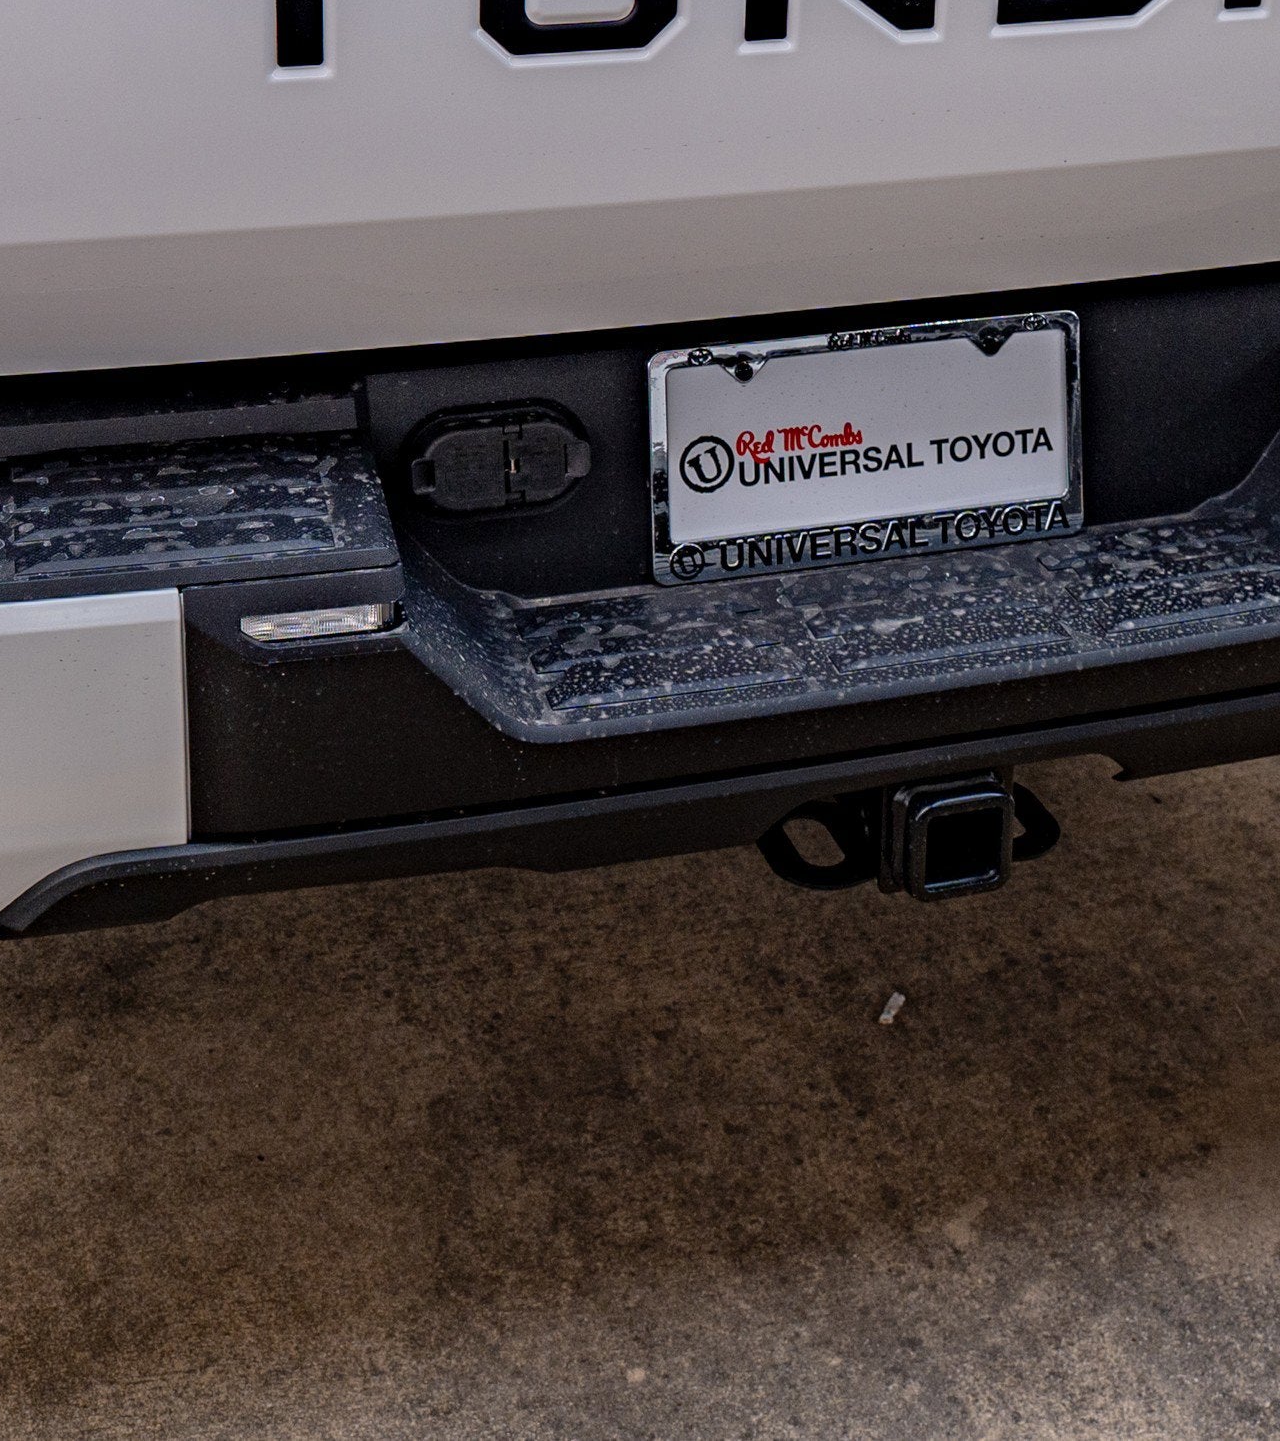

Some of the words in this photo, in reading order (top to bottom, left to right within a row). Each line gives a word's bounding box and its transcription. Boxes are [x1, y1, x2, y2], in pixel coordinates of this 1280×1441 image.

[736, 430, 775, 464] Red
[777, 422, 863, 451] McCombs
[739, 443, 924, 486] UNIVERSAL
[929, 427, 1053, 464] TOYOTA
[719, 518, 929, 572] UNIVERSAL
[933, 501, 1070, 544] TOYOTA
